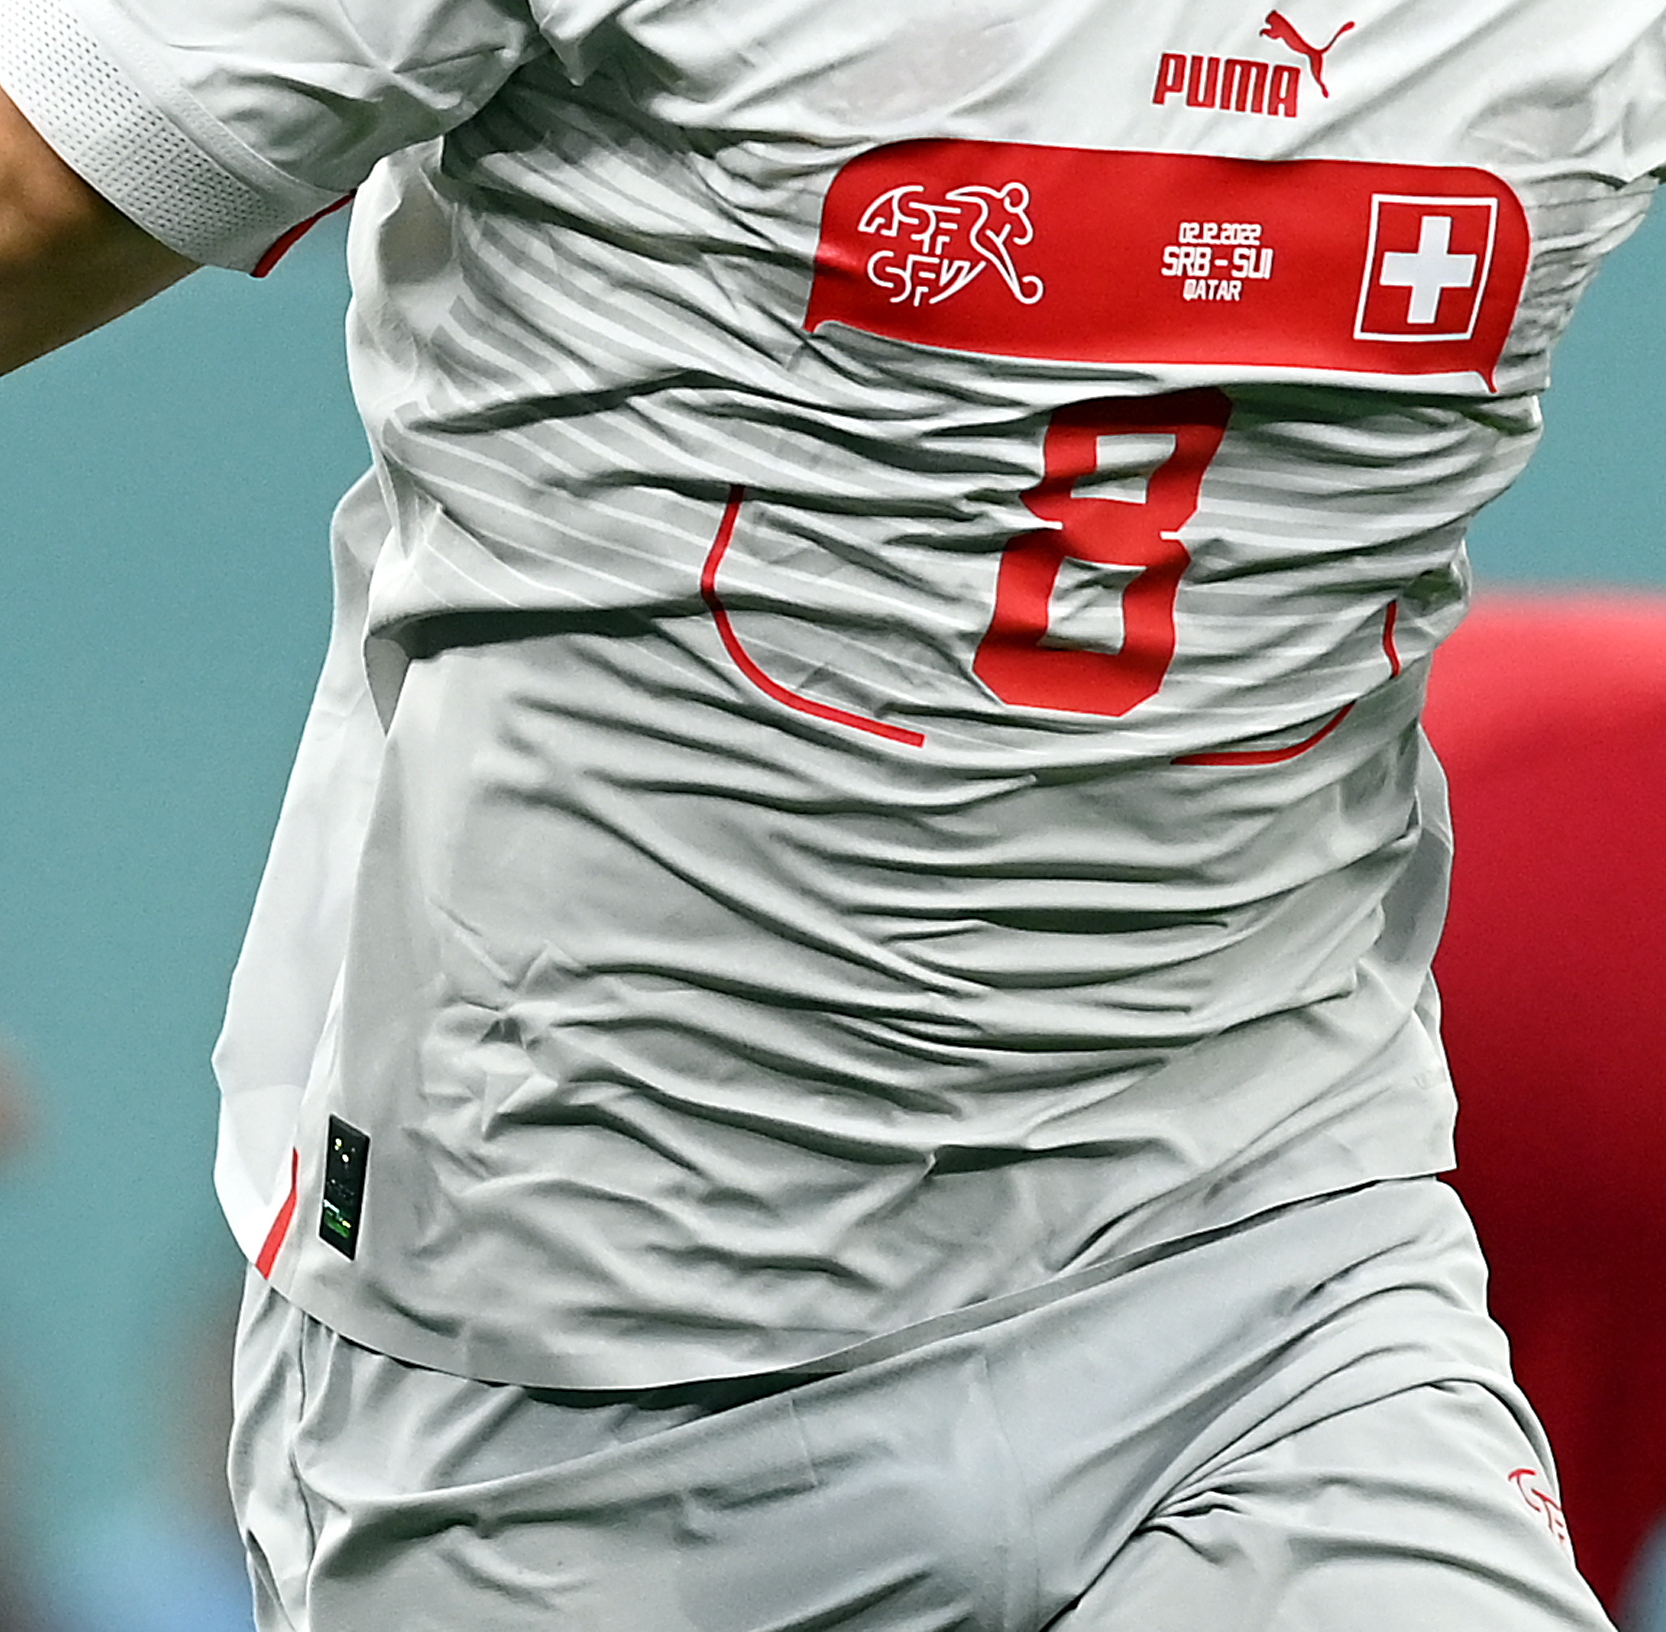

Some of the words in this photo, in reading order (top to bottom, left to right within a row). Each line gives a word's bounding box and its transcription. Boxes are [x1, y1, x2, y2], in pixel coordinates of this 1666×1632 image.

[1152, 52, 1301, 118] PUMA
[1178, 222, 1262, 246] 02.12.2022
[1161, 246, 1212, 276] SRB
[1231, 247, 1273, 280] SUI
[1183, 279, 1242, 301] QATAR
[972, 387, 1233, 717] 8
